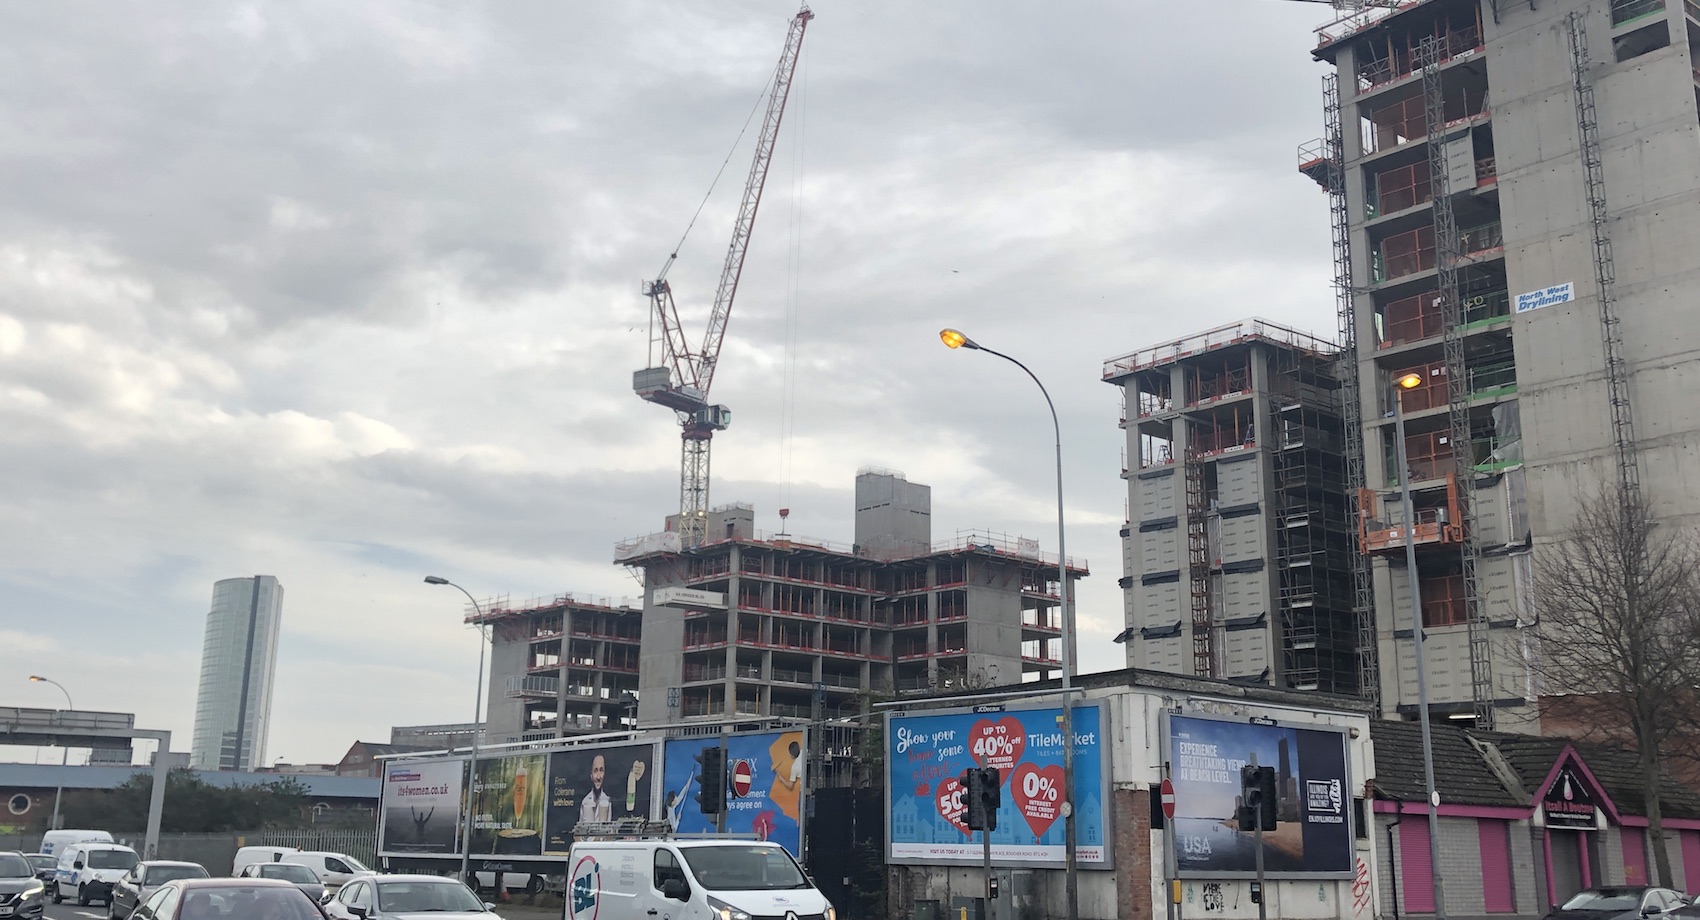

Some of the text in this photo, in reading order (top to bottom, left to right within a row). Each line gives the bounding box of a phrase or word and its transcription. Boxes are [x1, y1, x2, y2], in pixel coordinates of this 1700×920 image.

[1518, 285, 1569, 302] North West
[1518, 293, 1569, 311] Drylining
[983, 725, 1006, 735] UP TO
[897, 727, 956, 754] Show your
[973, 735, 1021, 757] 40% off
[1028, 732, 1095, 747] TileMket
[938, 745, 964, 761] some
[1180, 742, 1217, 757] EXPERIENCE
[1180, 755, 1226, 770] BREATHTAKING
[554, 776, 566, 785] From
[1181, 768, 1232, 784] AT BEACH LEVEL.
[397, 783, 449, 797] its4women.co.uk
[554, 787, 575, 797] Coleraine
[947, 781, 958, 791] UP
[1023, 772, 1057, 801] 0%
[553, 798, 574, 807] with love
[736, 801, 753, 811] agree
[1028, 799, 1052, 807] INTEREST
[1026, 811, 1053, 819] AVAILABLE
[1038, 806, 1055, 814] CREDIT
[1184, 836, 1212, 854] USA
[1205, 901, 1225, 912] LOVE
